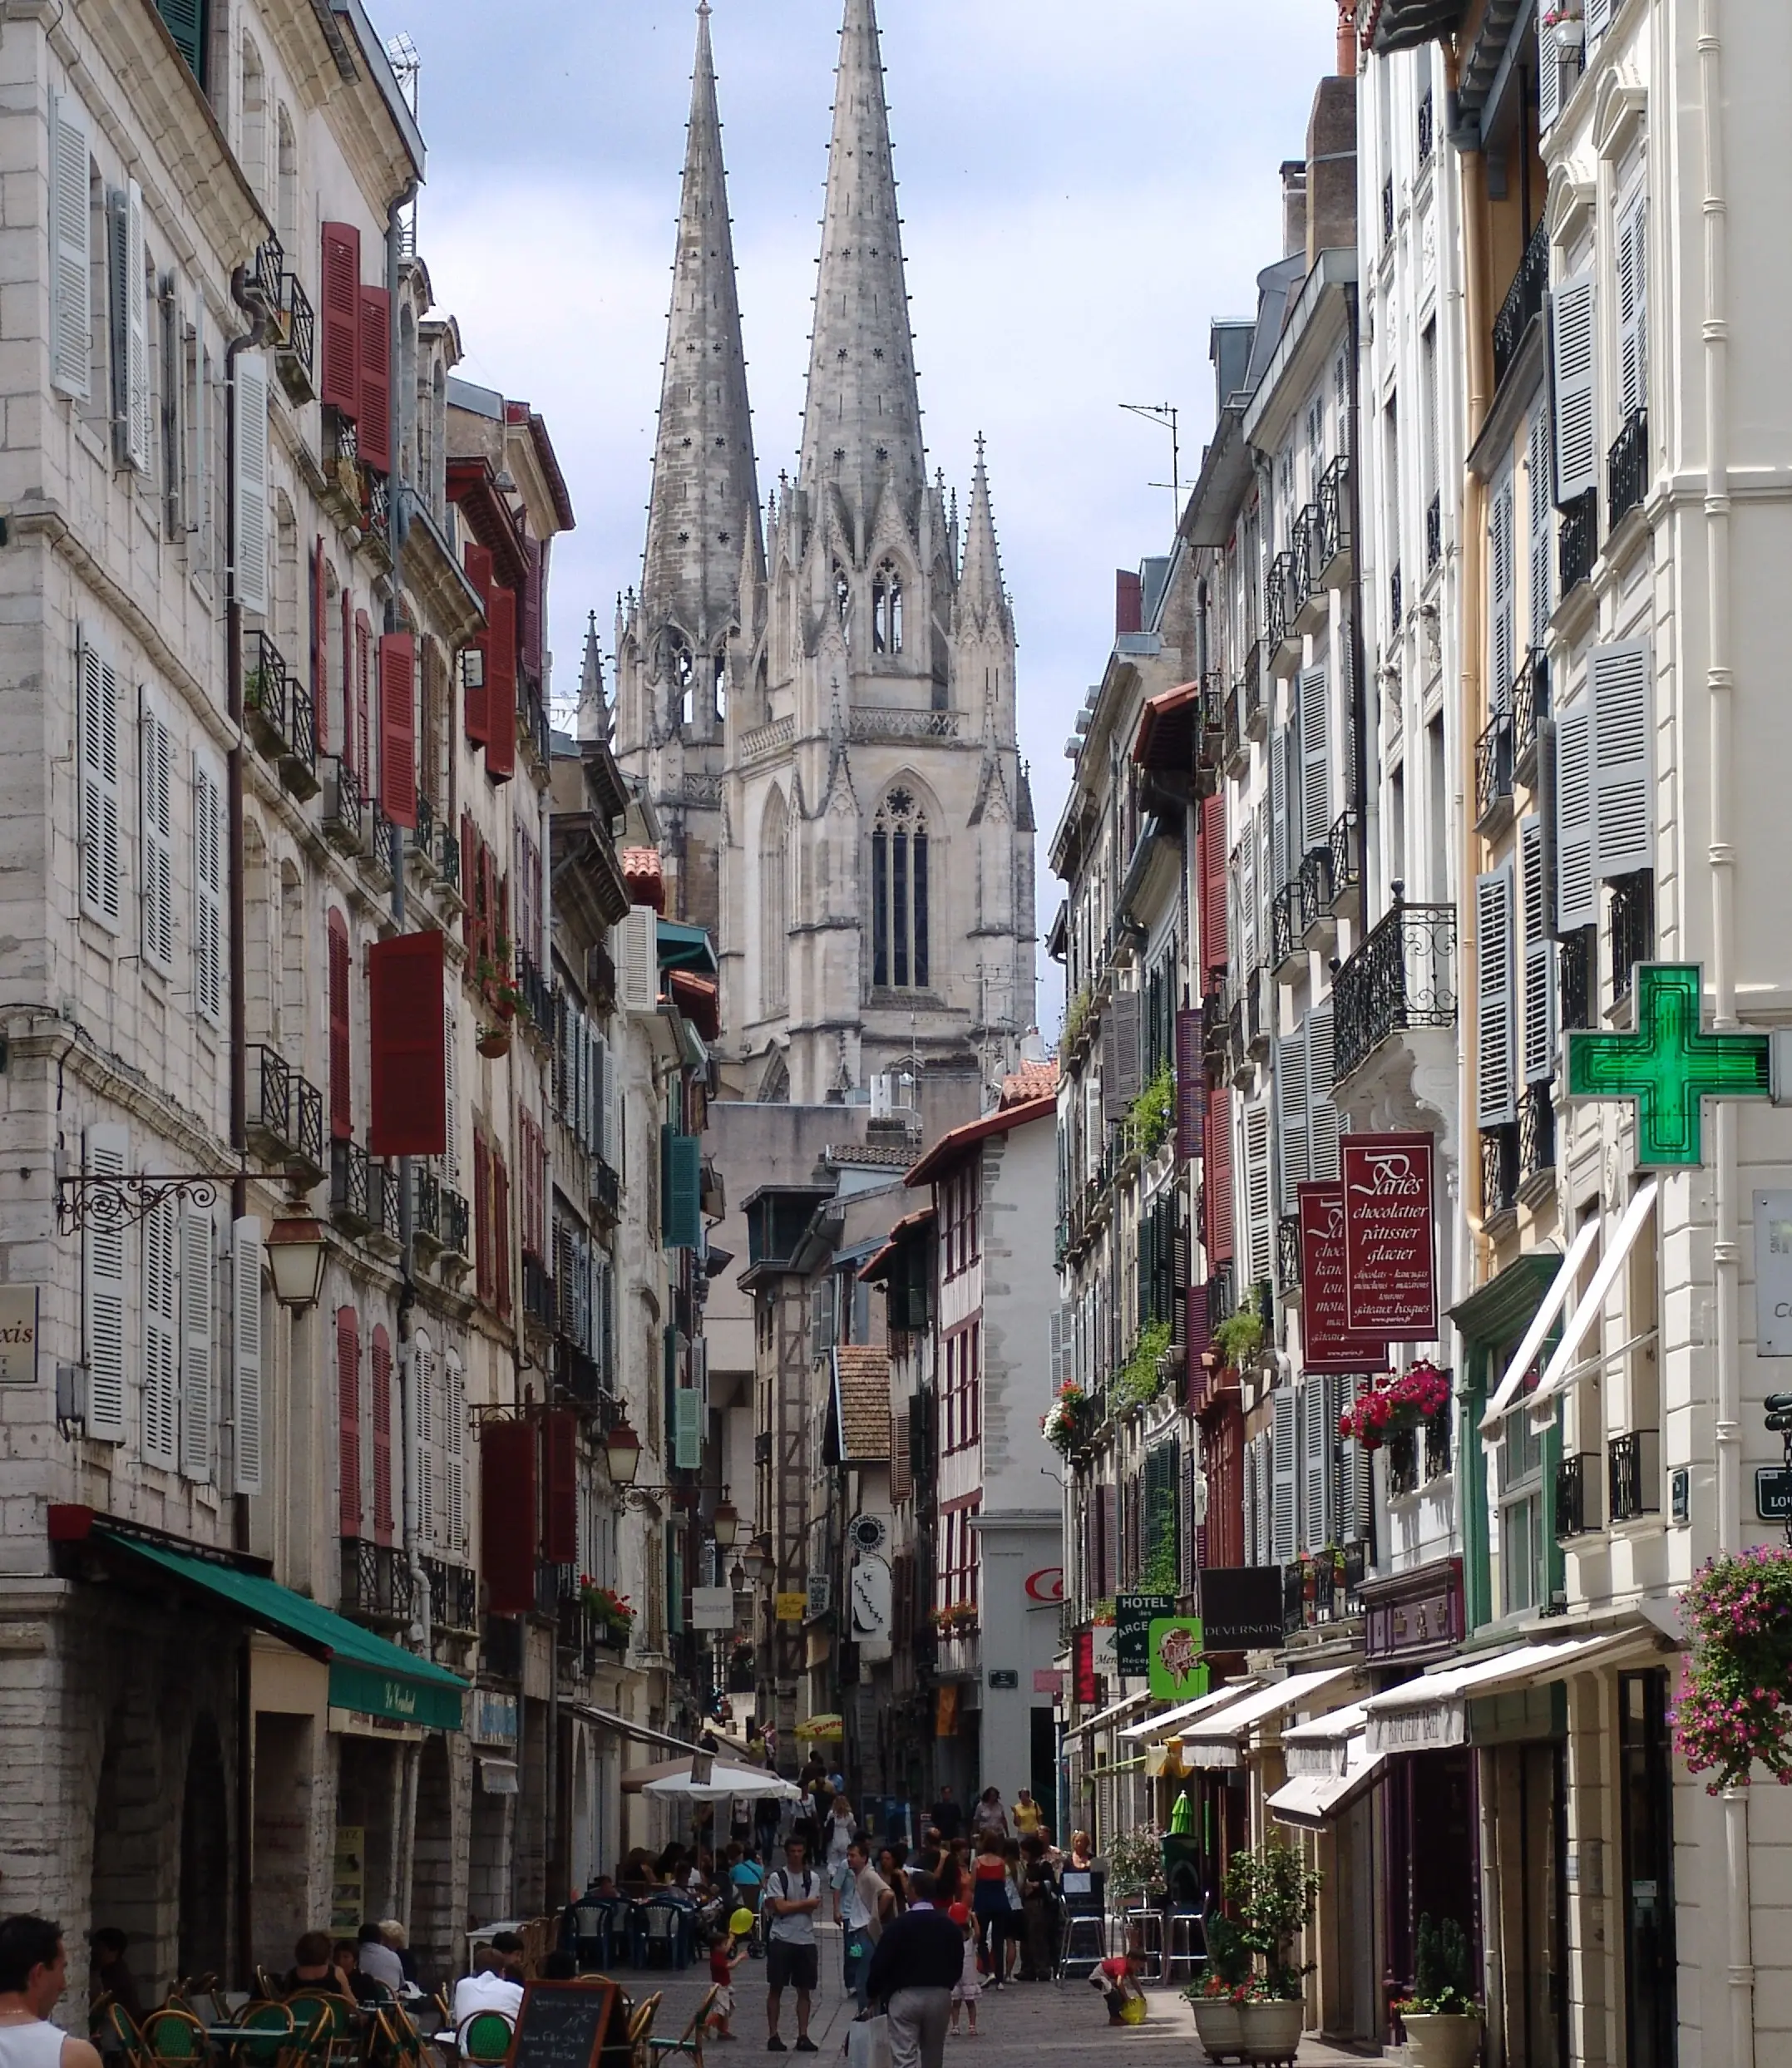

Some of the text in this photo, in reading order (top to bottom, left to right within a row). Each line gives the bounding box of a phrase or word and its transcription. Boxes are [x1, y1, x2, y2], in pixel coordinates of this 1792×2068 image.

[1353, 1202, 1429, 1219] chocolatier
[1361, 1223, 1421, 1245] pâtissier
[1365, 1244, 1416, 1266] glacier
[0, 1320, 33, 1343] xis
[1122, 1597, 1168, 1609] HOTEL
[1118, 1621, 1148, 1639] ARCE
[1205, 1624, 1281, 1636] DEVERNOIS
